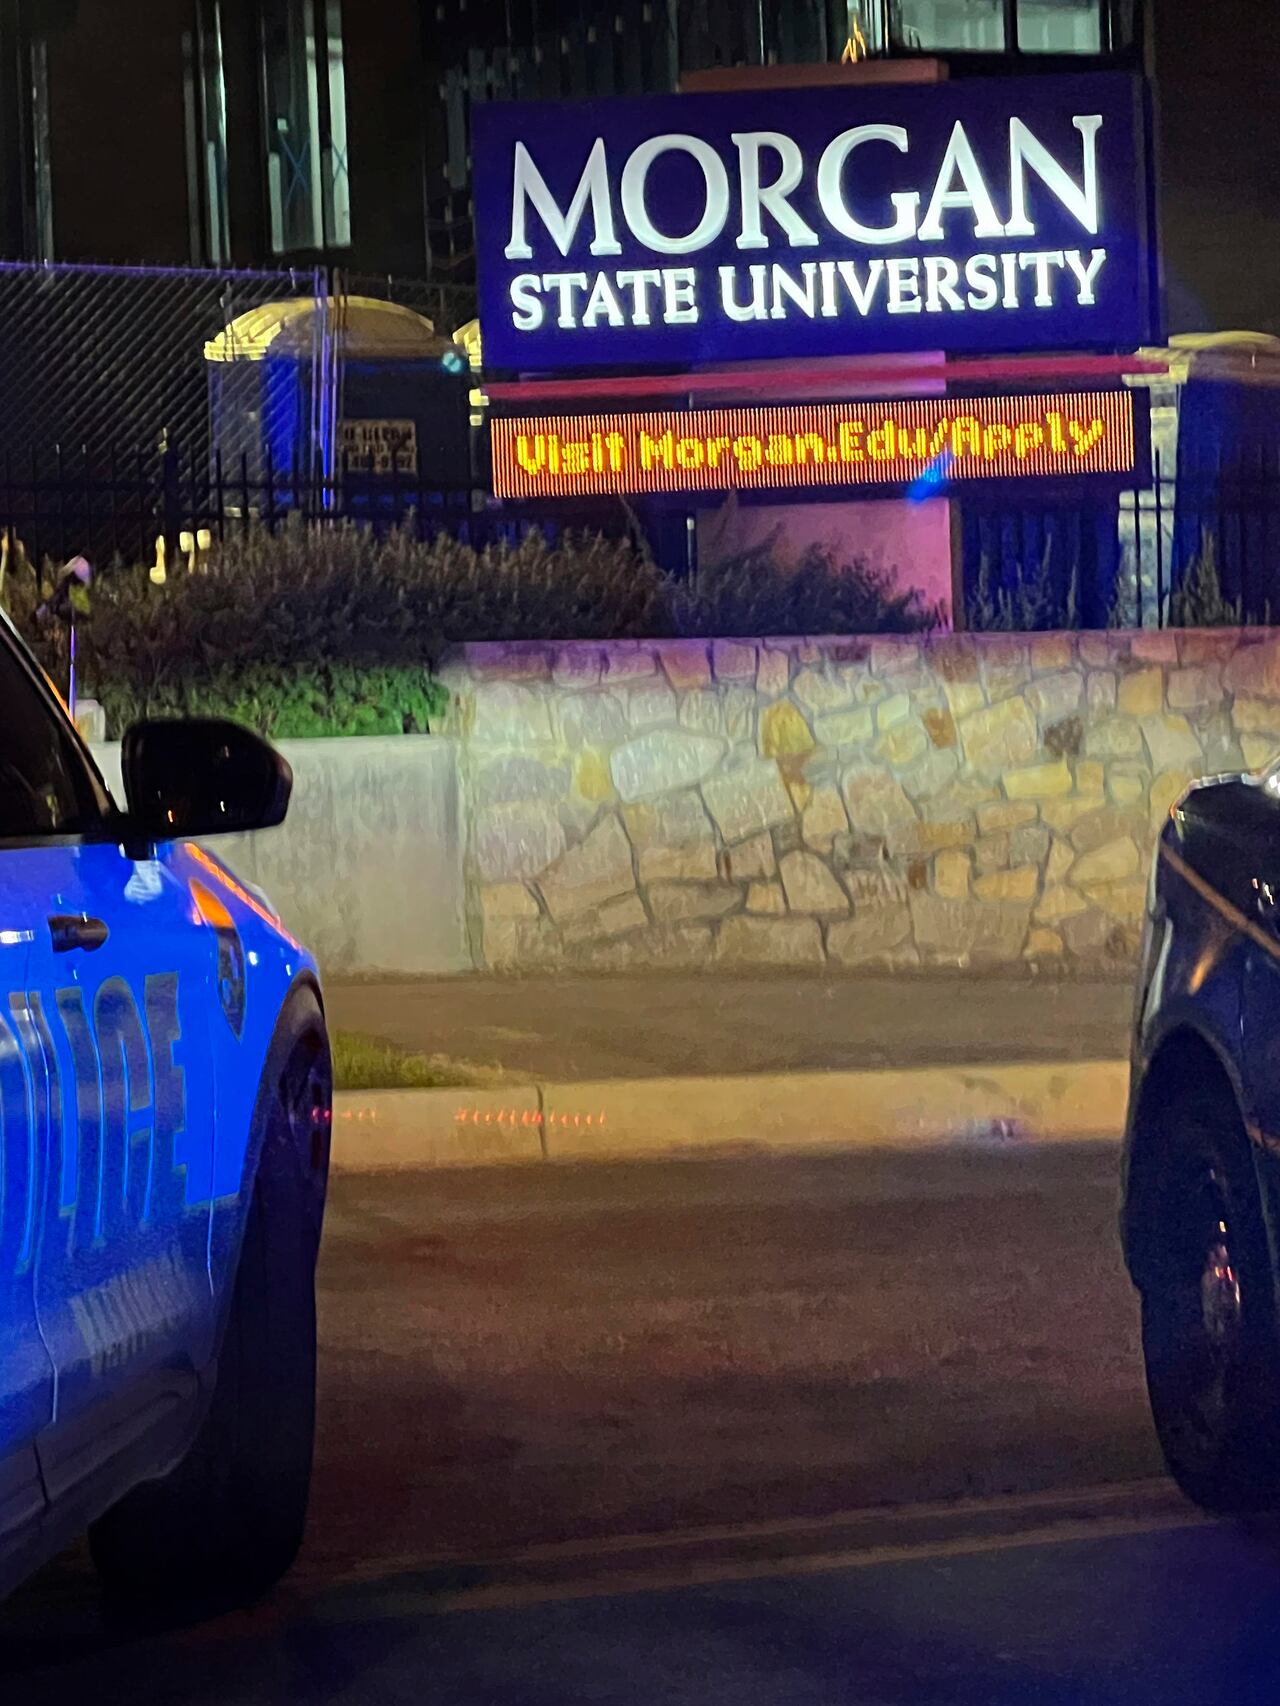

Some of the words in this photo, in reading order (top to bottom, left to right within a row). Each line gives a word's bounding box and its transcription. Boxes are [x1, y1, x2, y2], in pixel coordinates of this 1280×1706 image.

[504, 114, 1104, 260] MORGAN
[509, 267, 699, 331] STATE
[720, 248, 1106, 322] UNIVERSITY
[517, 431, 624, 475] Visit
[639, 411, 1106, 471] Morgan.Edu/Apply
